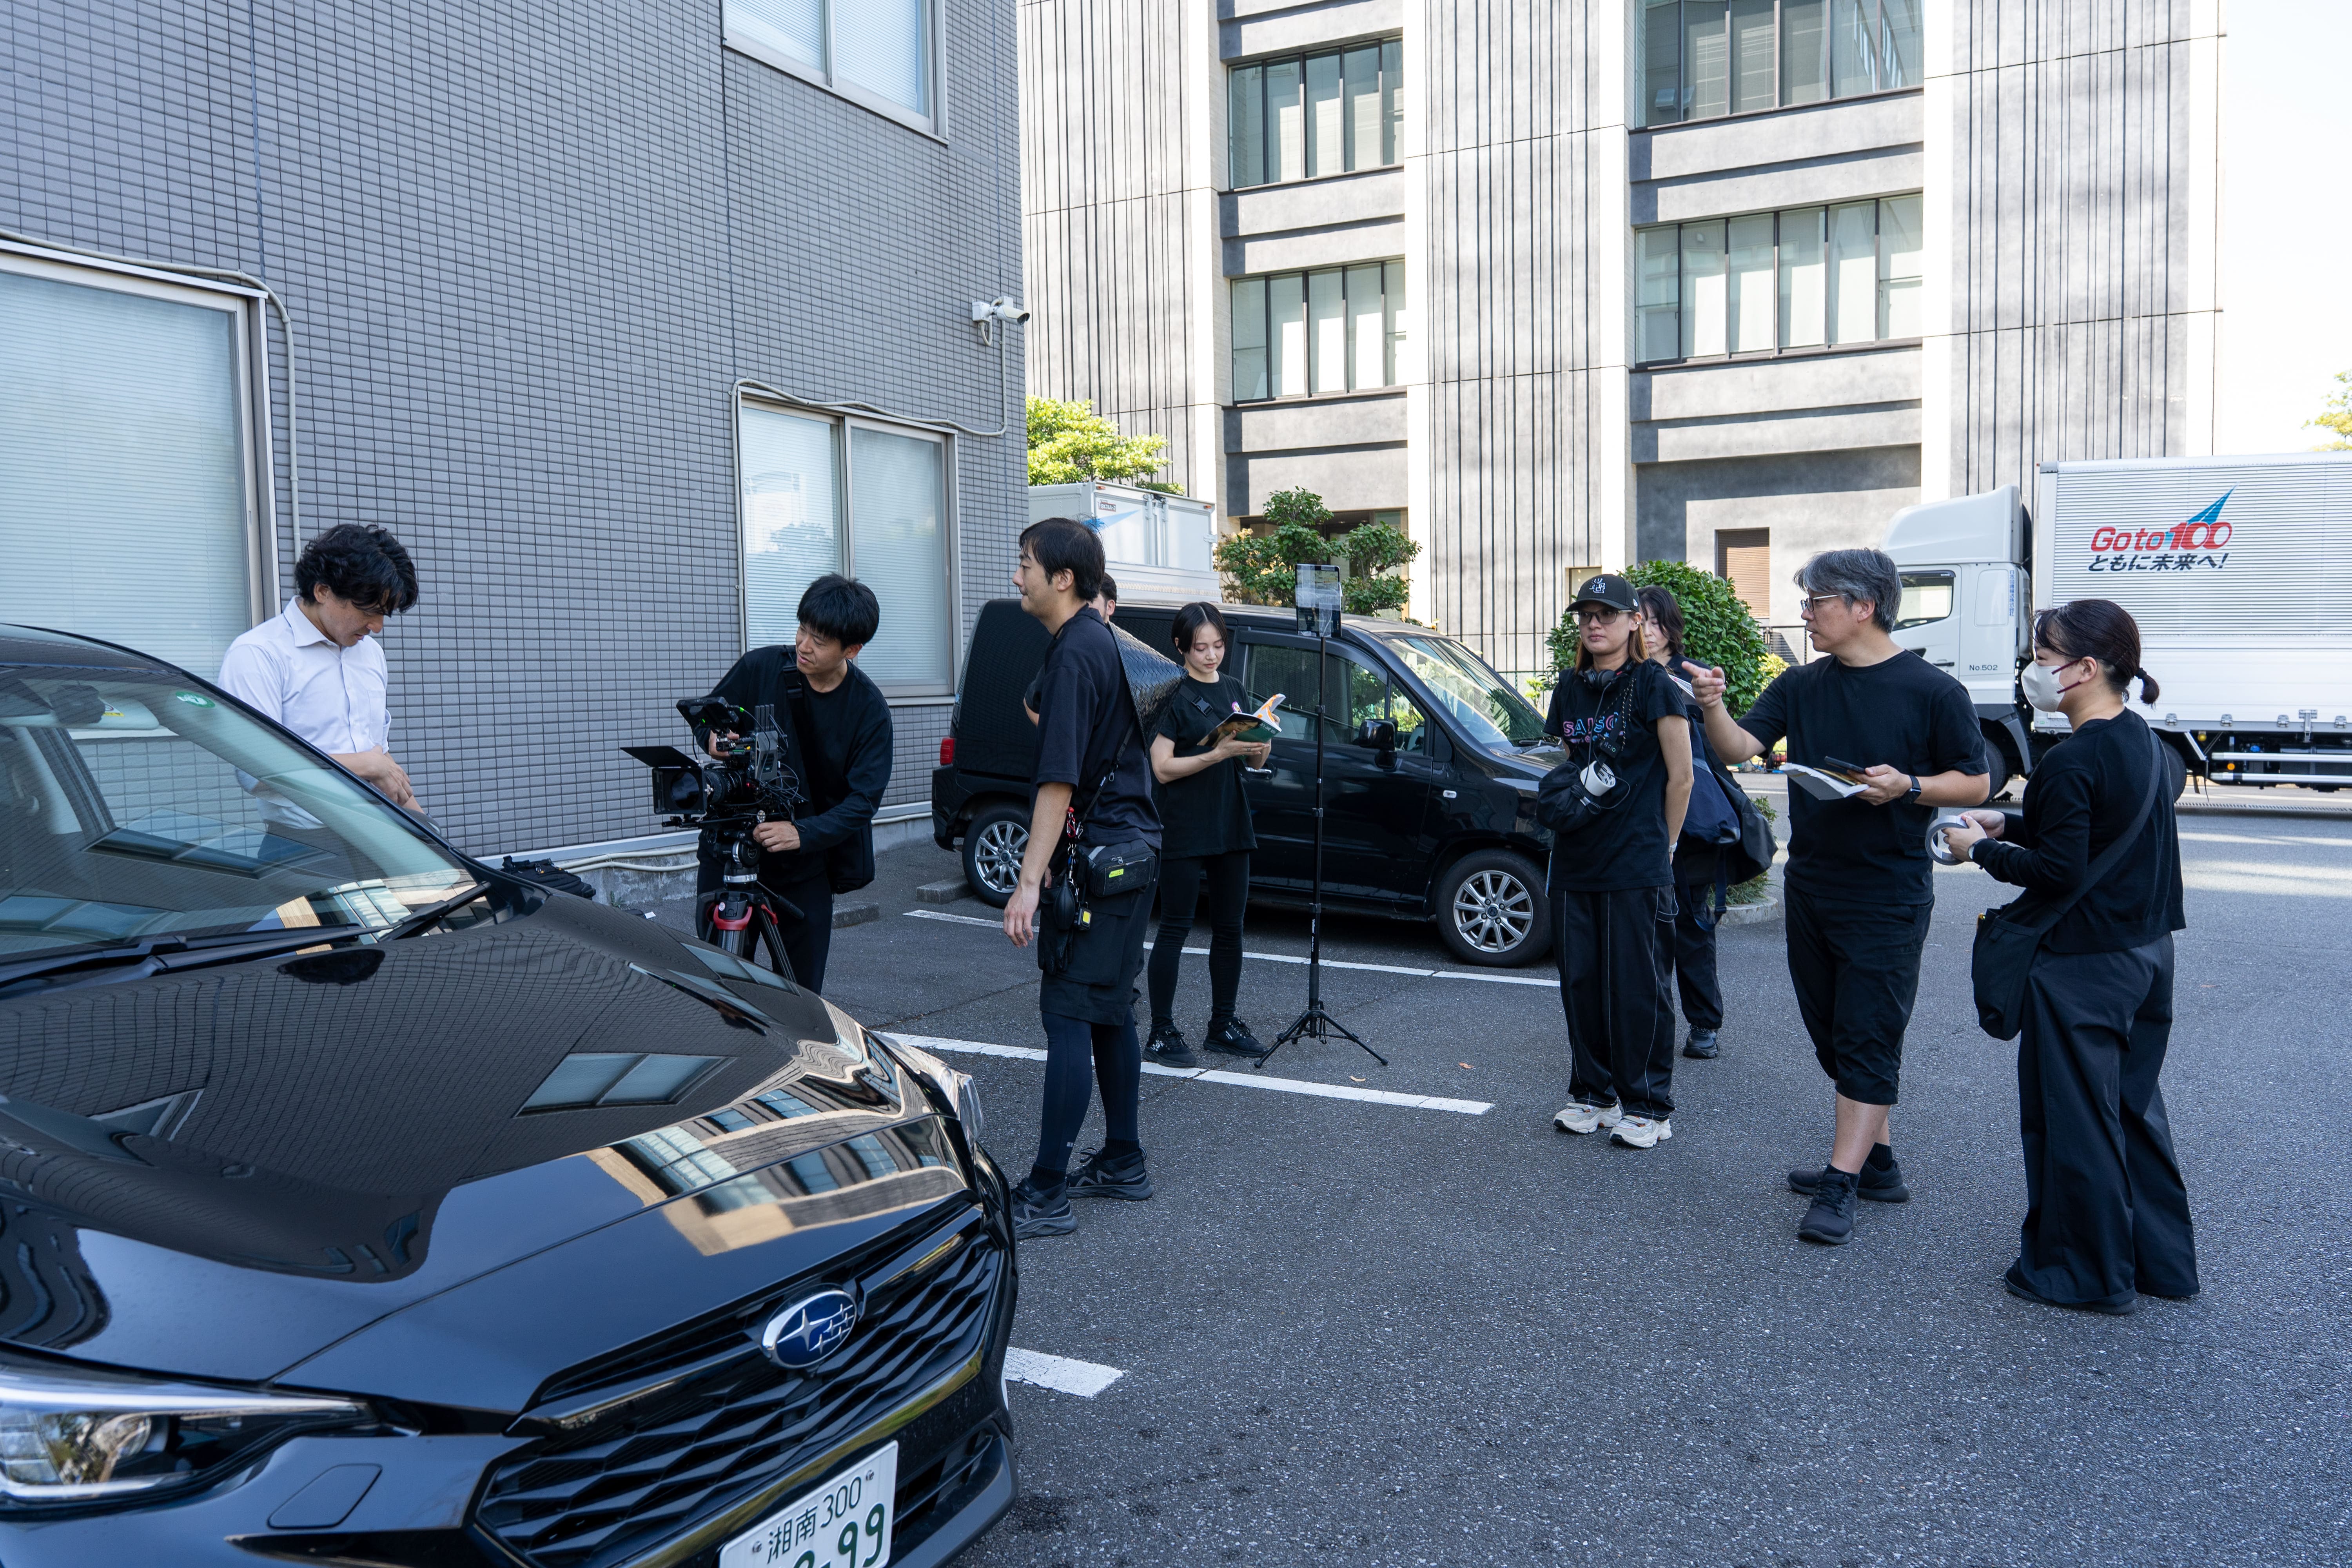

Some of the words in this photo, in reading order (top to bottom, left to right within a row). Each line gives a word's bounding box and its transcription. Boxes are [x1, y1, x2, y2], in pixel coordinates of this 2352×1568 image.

[2088, 553, 2229, 571] ともに未来へ!
[767, 1504, 818, 1564] 湘南
[820, 1477, 861, 1528] 300
